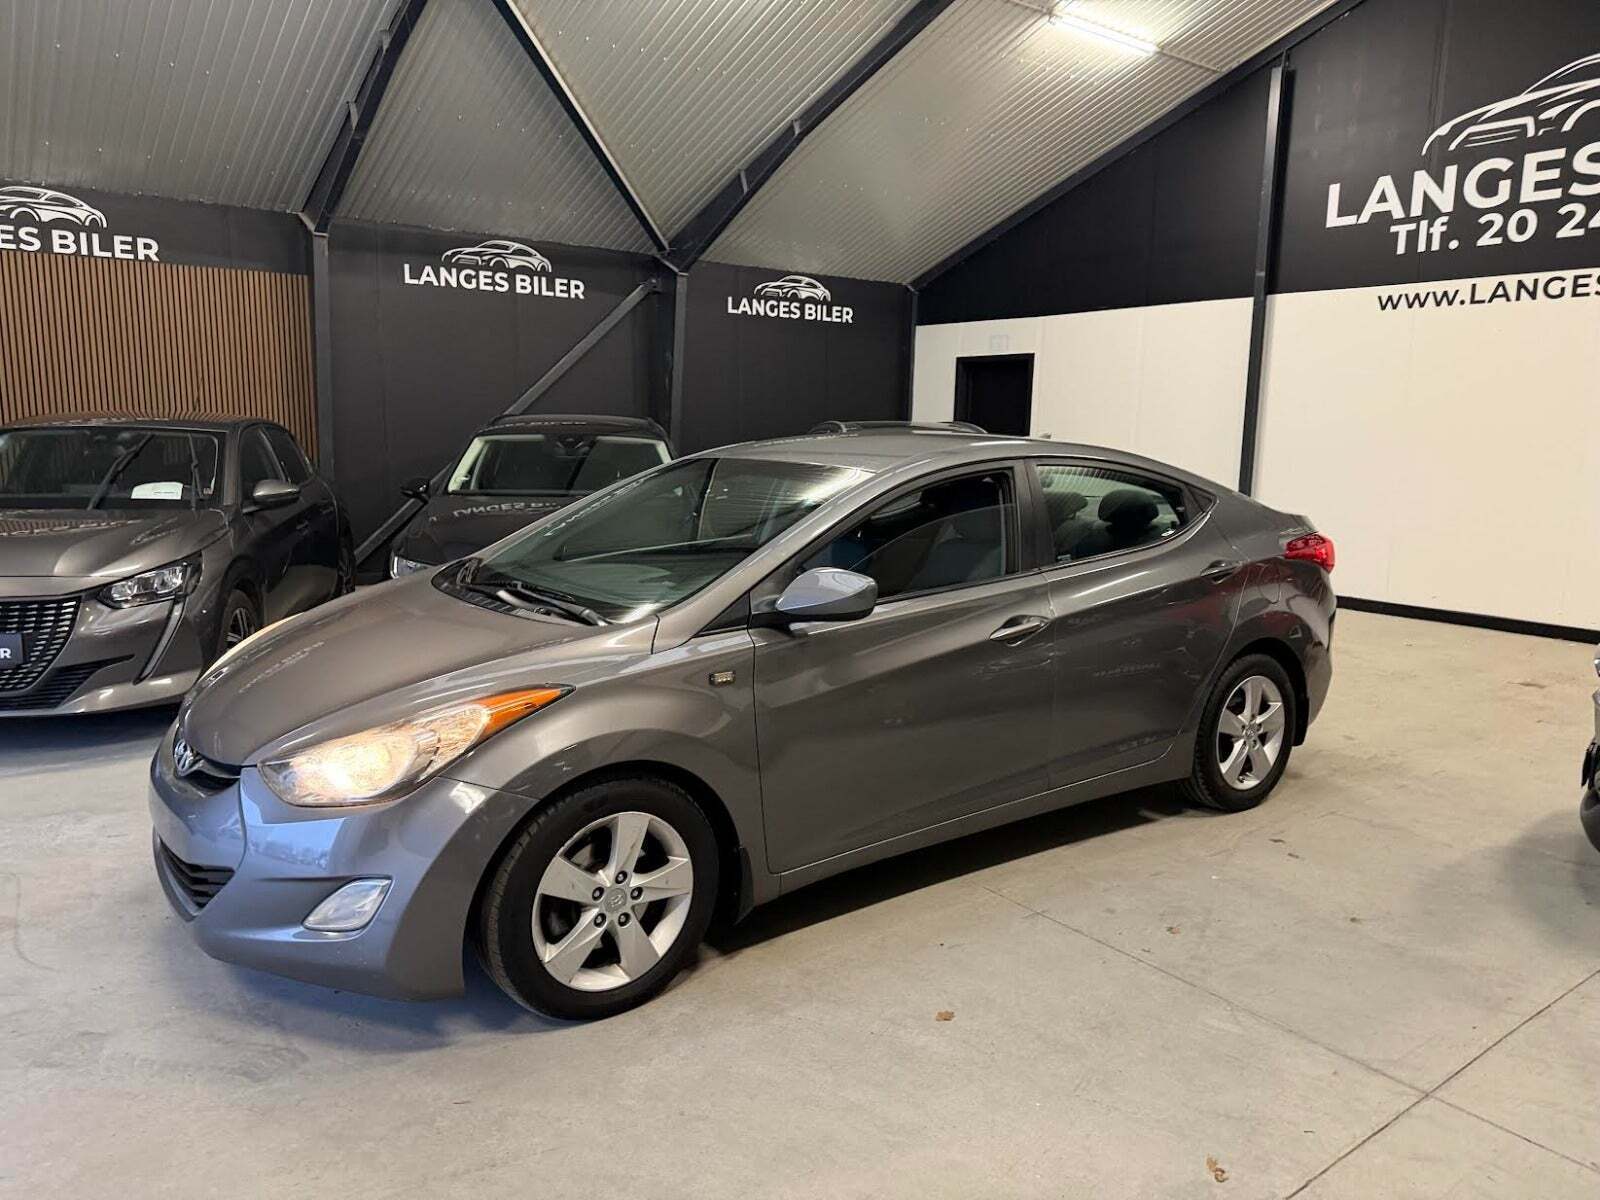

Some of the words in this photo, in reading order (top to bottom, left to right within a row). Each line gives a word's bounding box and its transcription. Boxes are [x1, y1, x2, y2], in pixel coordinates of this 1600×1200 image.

[1325, 141, 1600, 228] LANGES
[51, 229, 160, 262] BILER
[1390, 215, 1460, 255] Tlf.
[1476, 208, 1538, 247] 20
[403, 263, 510, 293] LANGES
[515, 273, 586, 300] BILER
[1377, 273, 1600, 311] www.LANGE
[727, 295, 801, 319] LANGES
[804, 303, 854, 324] BILER
